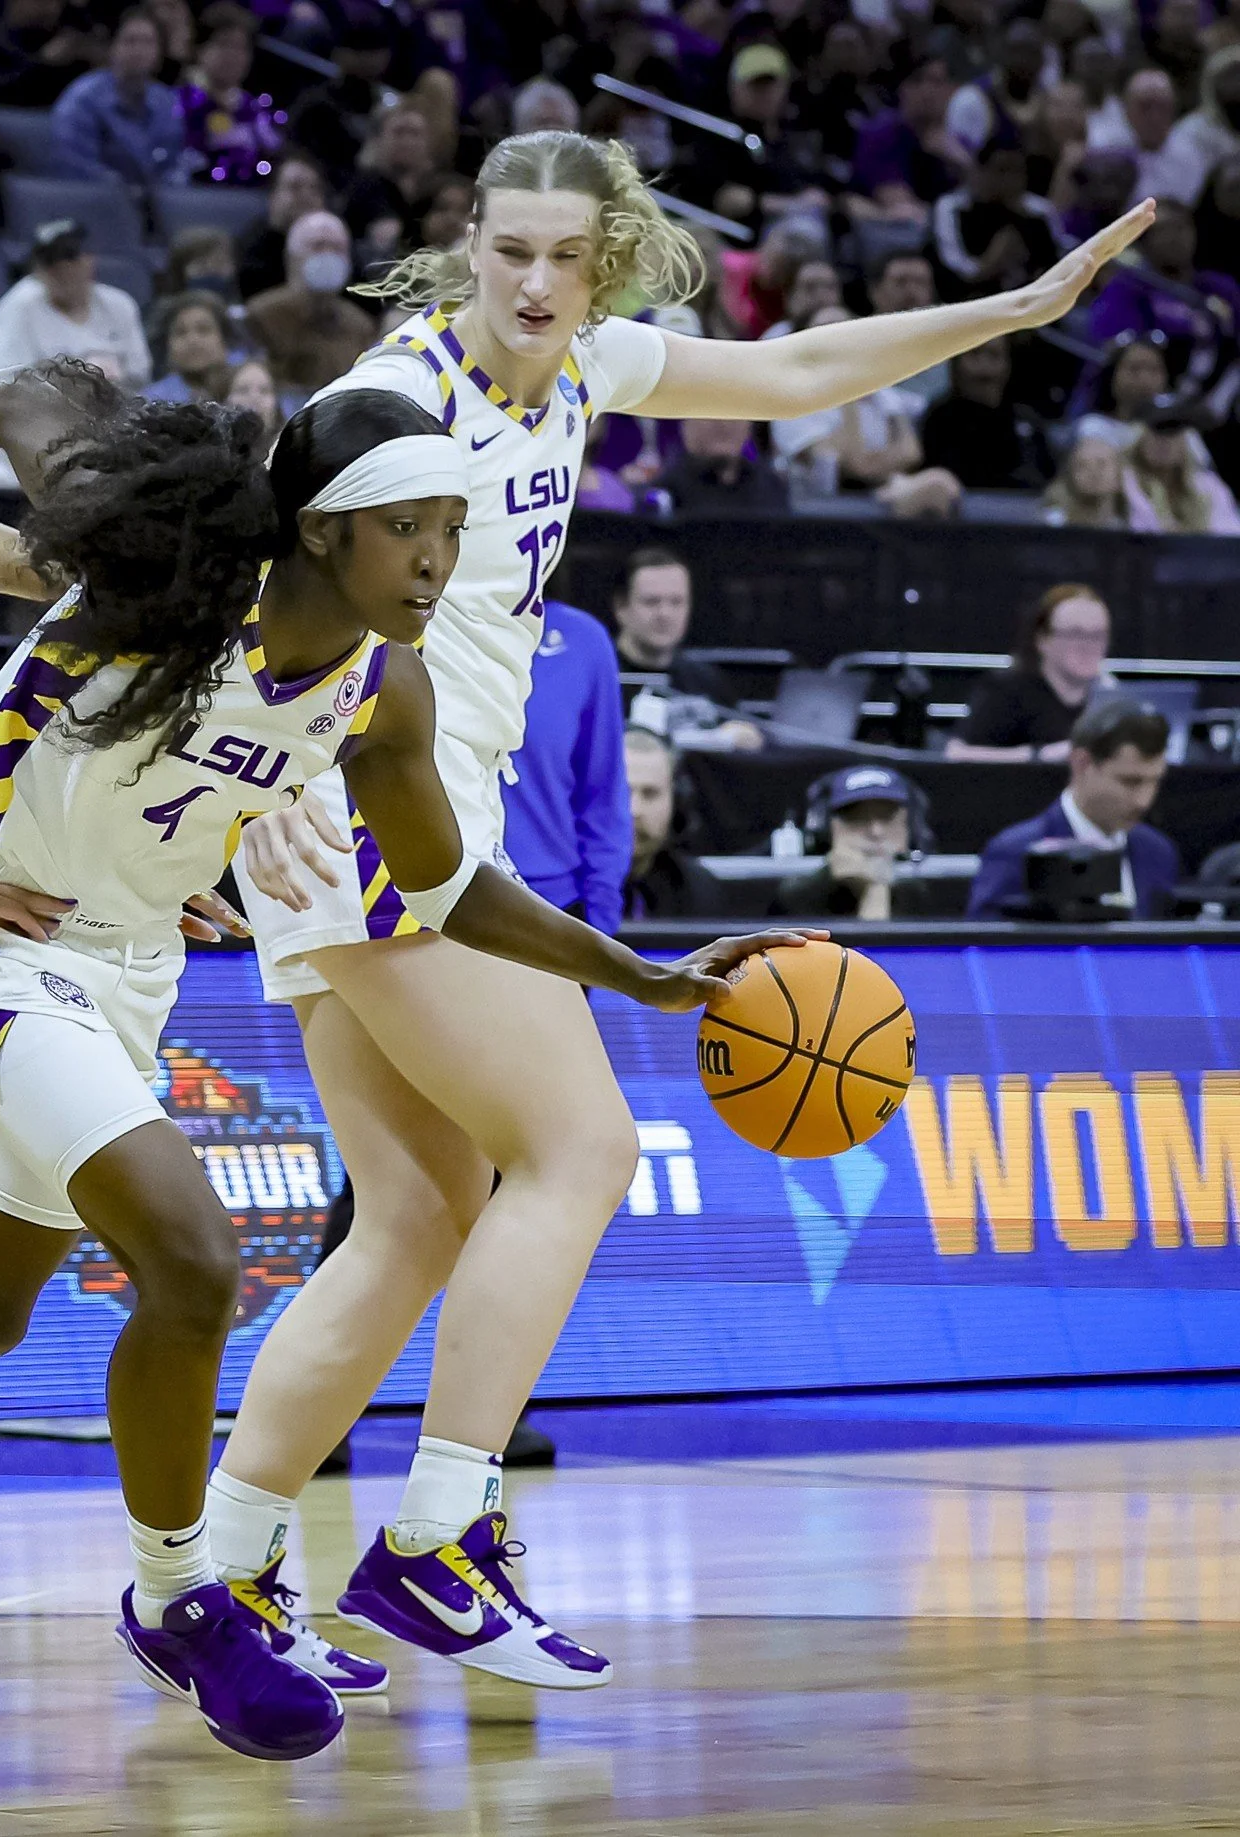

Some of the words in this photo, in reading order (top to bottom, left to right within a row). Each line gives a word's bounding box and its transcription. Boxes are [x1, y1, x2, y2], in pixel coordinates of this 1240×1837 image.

[505, 465, 570, 515] LSU
[165, 720, 290, 788] LSU
[142, 785, 218, 843] 4
[75, 917, 123, 929] TIGE
[192, 1143, 329, 1209] OUR
[903, 1071, 1240, 1255] WOM
